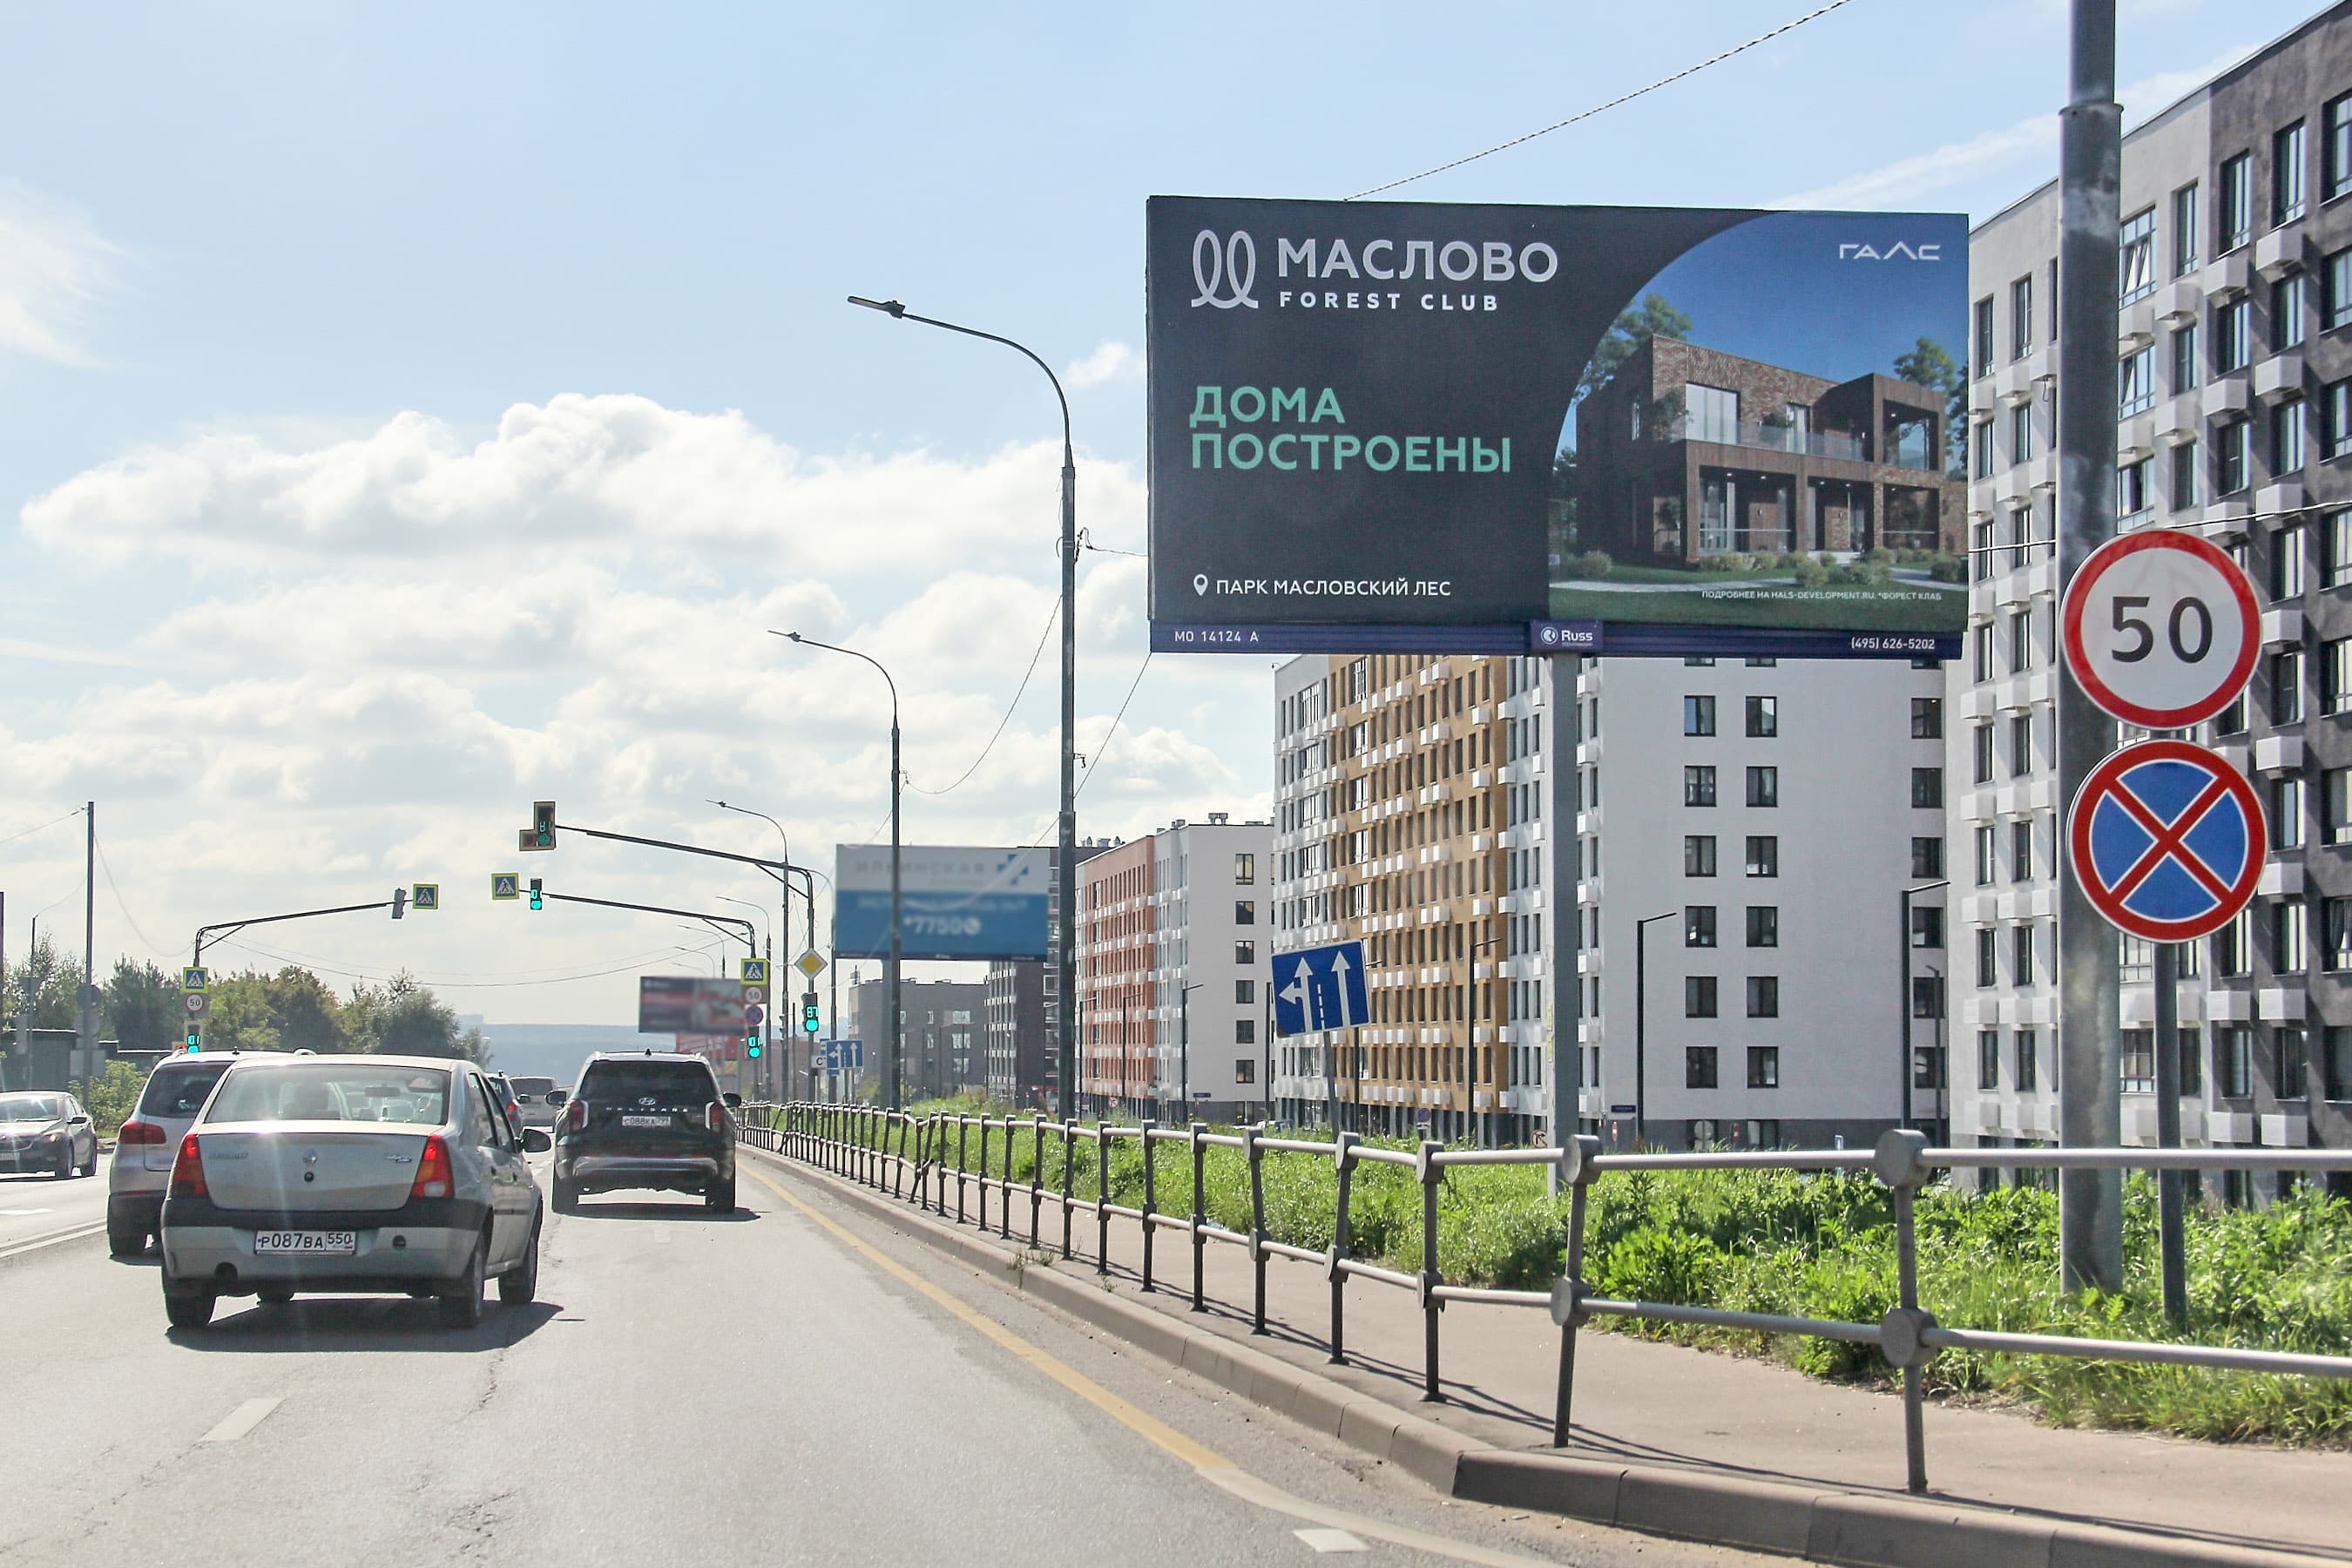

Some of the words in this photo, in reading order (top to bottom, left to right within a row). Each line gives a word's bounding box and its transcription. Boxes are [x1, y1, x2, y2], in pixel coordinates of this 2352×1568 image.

[1839, 240, 1941, 260] ГАЛС
[1277, 238, 1558, 283] МАСЛОВО
[1280, 291, 1402, 309] FOREST
[1421, 294, 1498, 311] CLUB
[1189, 386, 1346, 429] ДОМА
[1192, 433, 1511, 473] ПОСТРОЕНЫ
[1215, 578, 1268, 596] ПАРК
[1273, 577, 1407, 597] МАСЛОВСКИЙ
[1413, 580, 1451, 597] ЛЕС
[1702, 590, 1756, 599] ПОДРОБНЕЕ
[1756, 591, 1770, 599] НА
[1174, 631, 1194, 642] МО
[1200, 631, 1242, 643] 14124
[1561, 630, 1593, 642] Russ
[2111, 596, 2213, 664] 50
[1850, 637, 1879, 650] (495)
[1882, 637, 1936, 650] 626-5202
[189, 998, 201, 1007] 50
